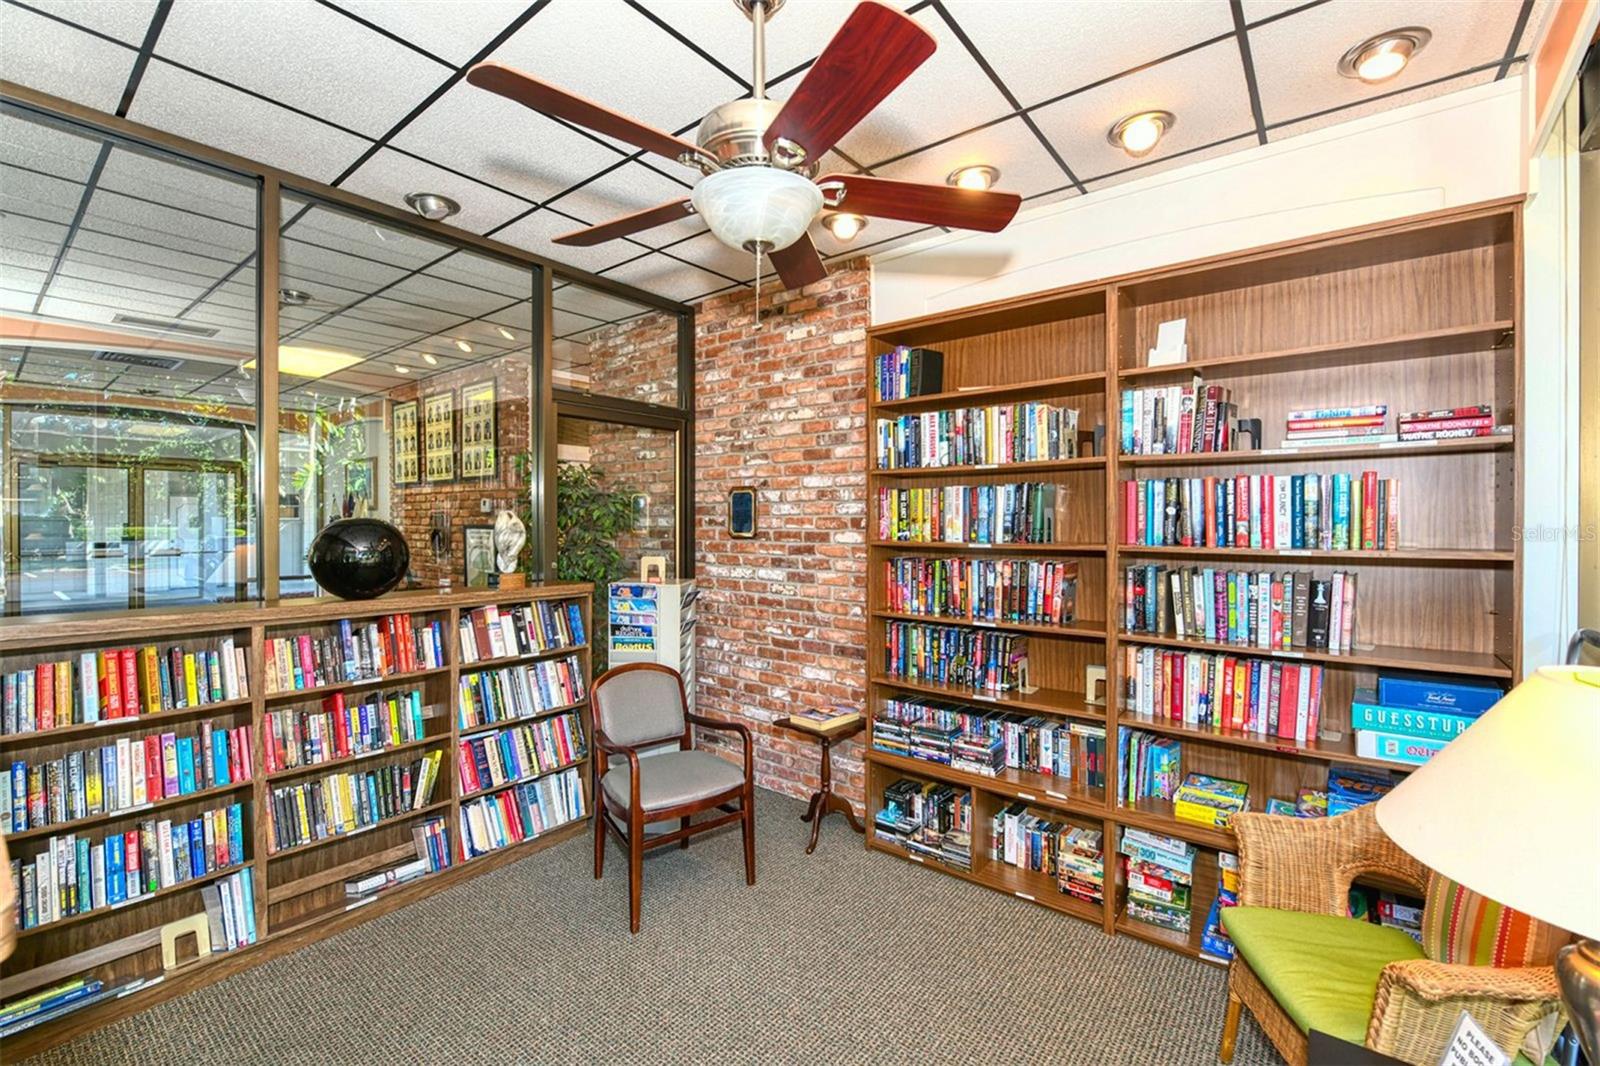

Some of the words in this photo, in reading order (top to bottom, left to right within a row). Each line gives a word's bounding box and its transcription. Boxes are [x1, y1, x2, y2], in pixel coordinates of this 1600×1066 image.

[1436, 428, 1474, 438] ROONEY
[1457, 1036, 1468, 1051] NO
[1466, 1030, 1494, 1064] PLEASE
